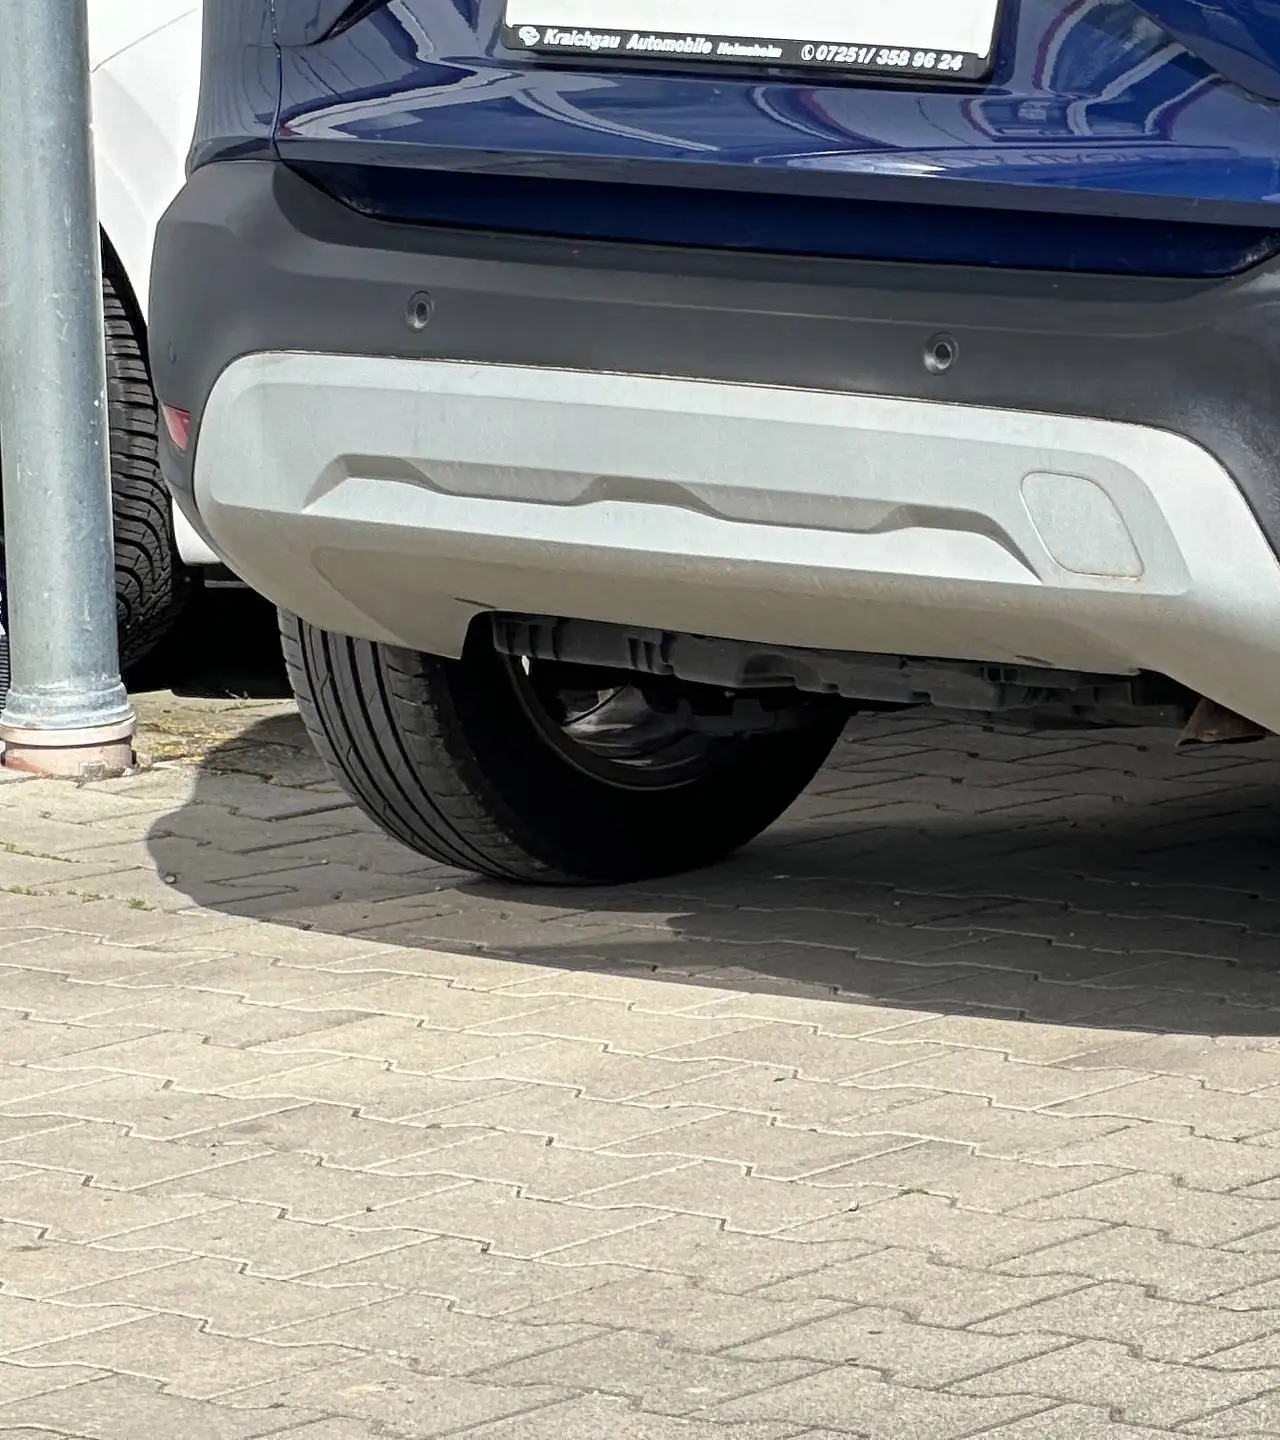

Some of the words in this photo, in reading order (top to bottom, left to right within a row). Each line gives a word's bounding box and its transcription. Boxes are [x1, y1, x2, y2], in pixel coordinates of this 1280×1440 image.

[543, 28, 621, 51] Kraichgau
[626, 33, 713, 55] Automobile
[876, 49, 911, 67] 358
[911, 51, 937, 69] 96
[937, 53, 964, 71] 24
